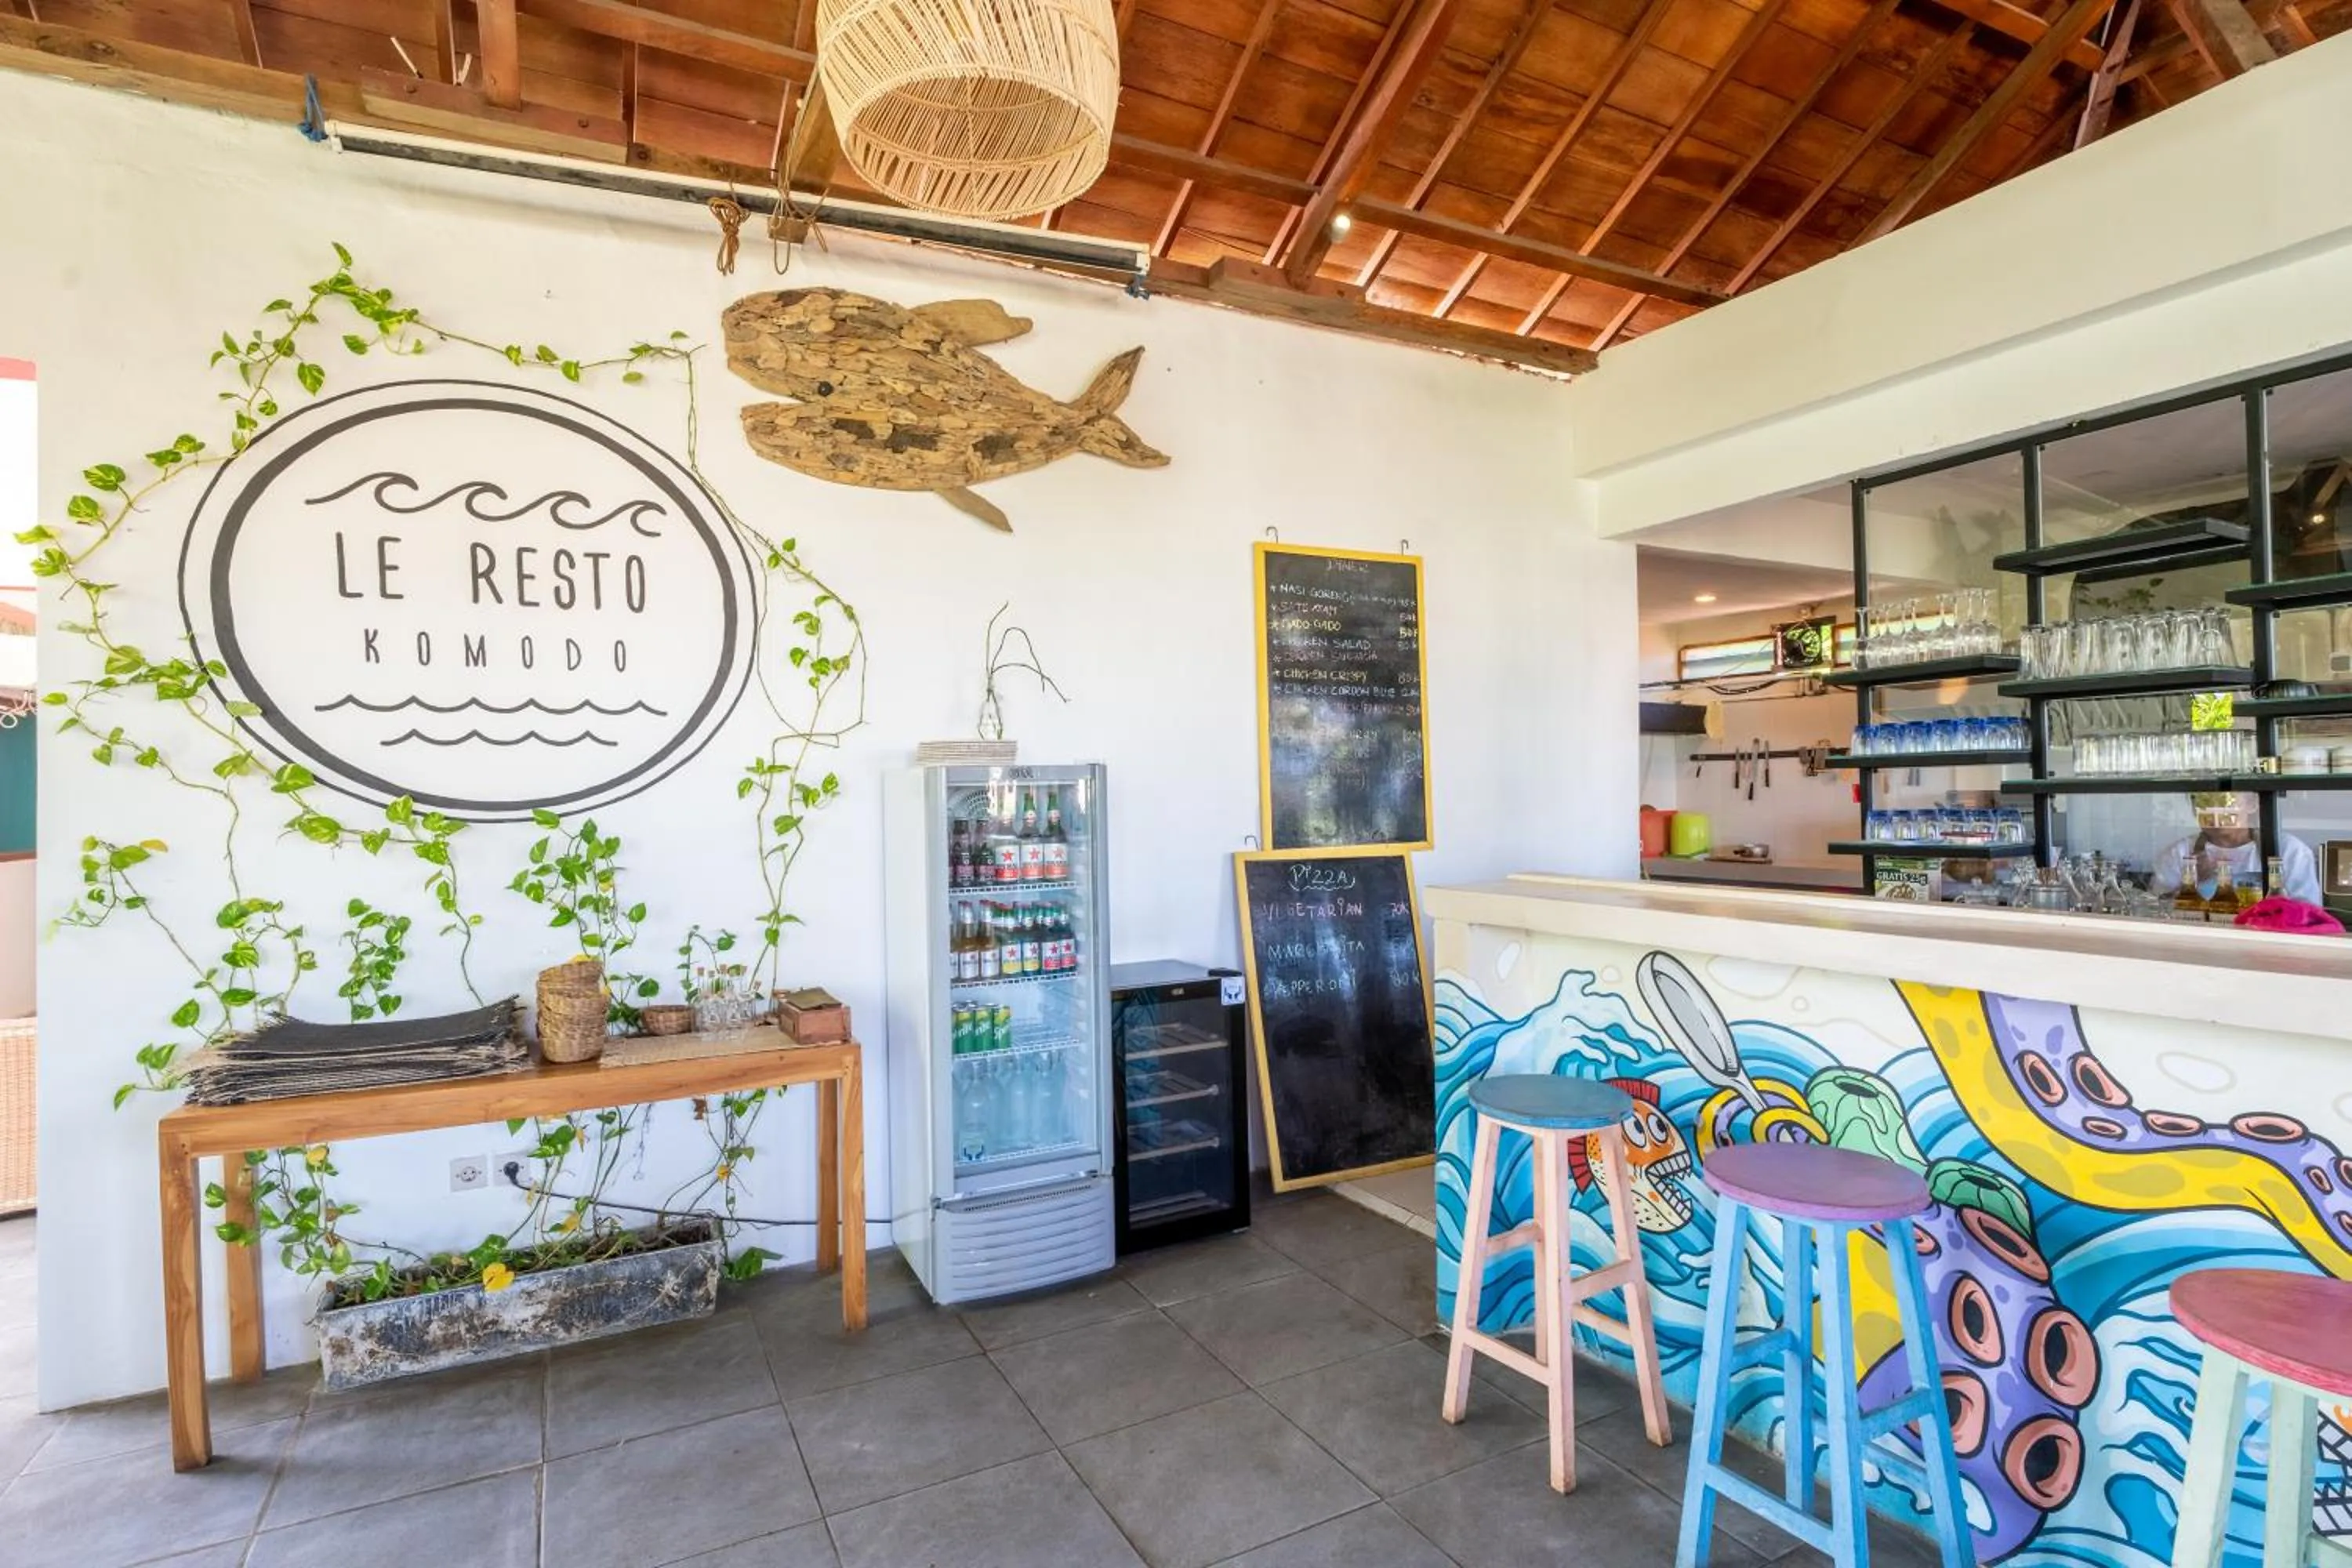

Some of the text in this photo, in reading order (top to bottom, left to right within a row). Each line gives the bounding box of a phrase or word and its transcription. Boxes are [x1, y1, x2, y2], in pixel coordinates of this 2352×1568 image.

[335, 532, 646, 612] LE RESTO
[365, 629, 626, 672] KOMODO
